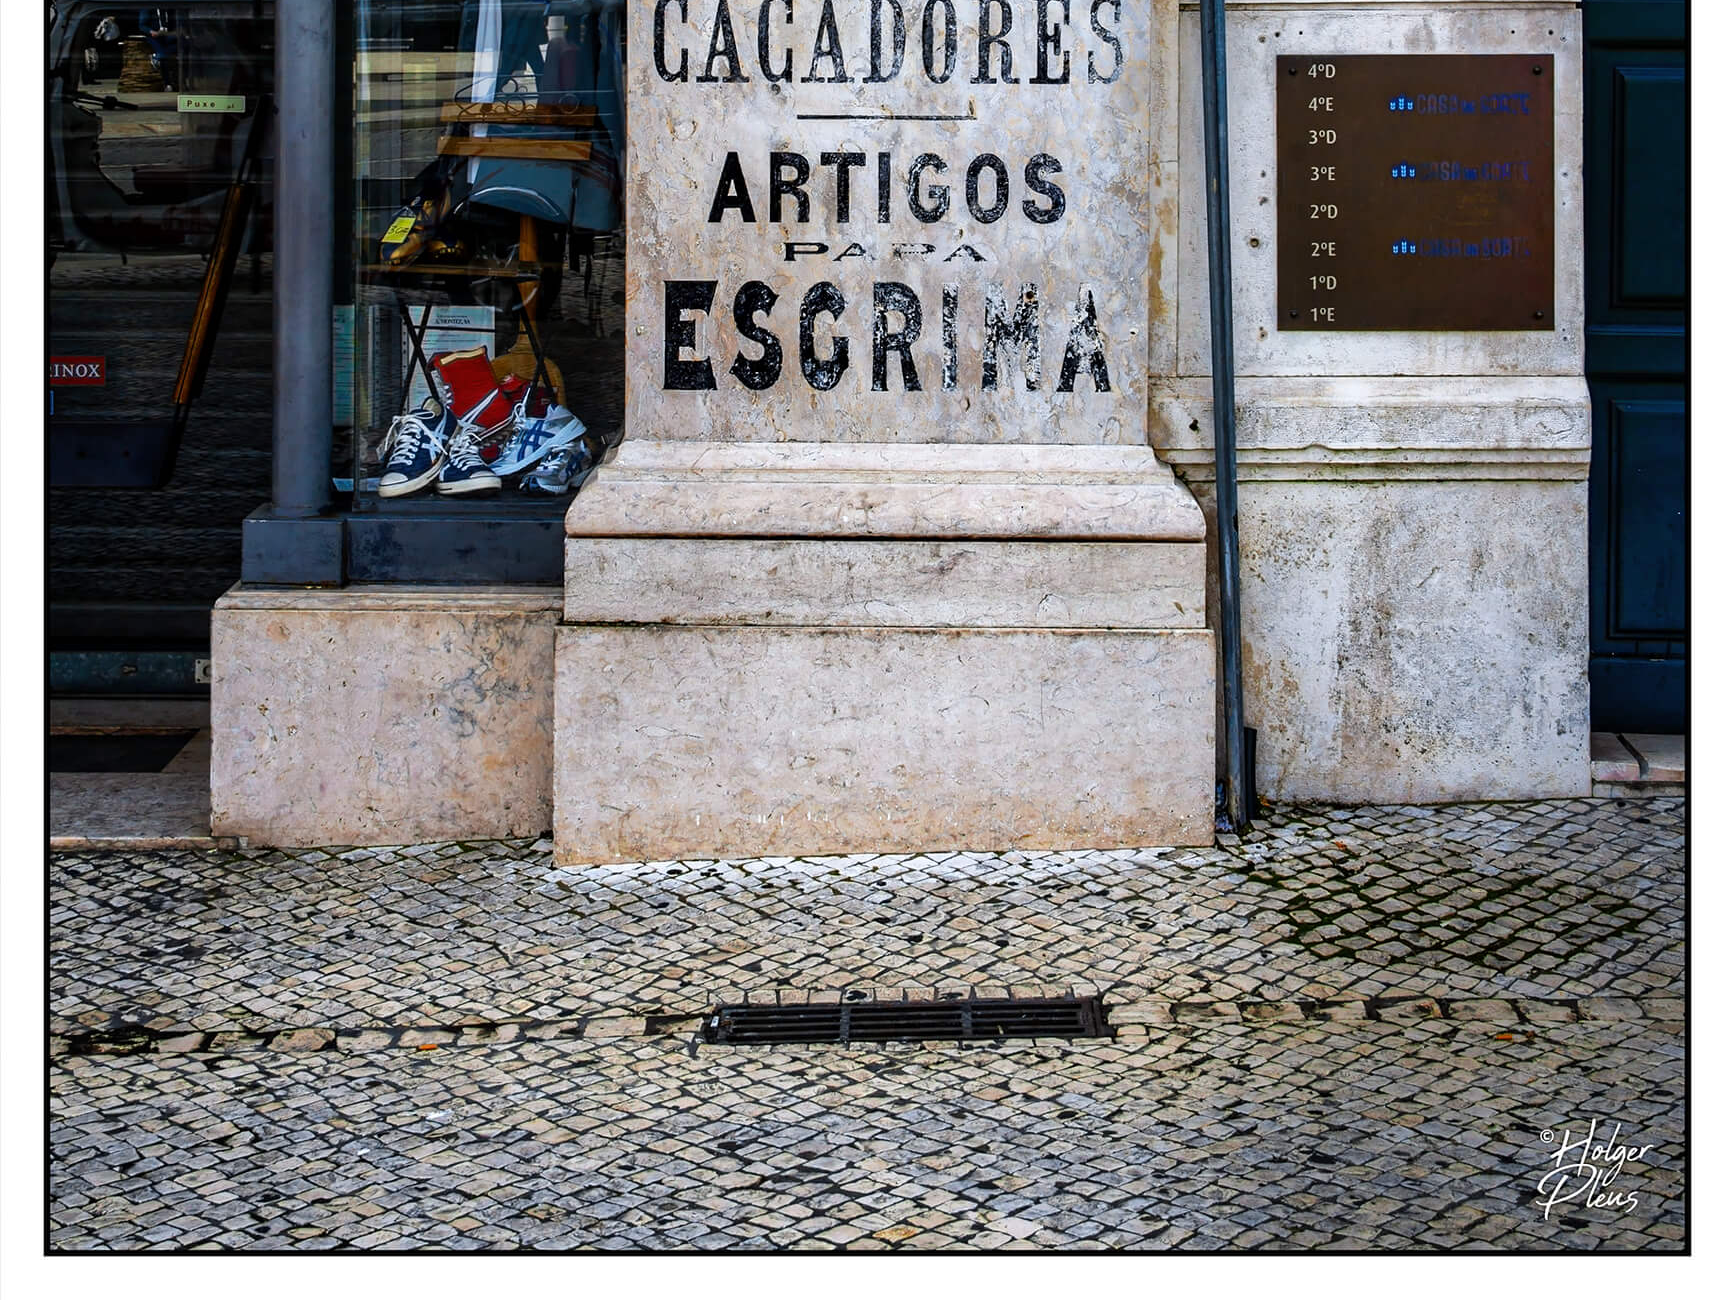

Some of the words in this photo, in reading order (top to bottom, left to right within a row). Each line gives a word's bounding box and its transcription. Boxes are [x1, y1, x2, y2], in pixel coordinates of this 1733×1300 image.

[1308, 64, 1335, 78] 4ºD
[187, 100, 216, 108] Puxe
[1309, 97, 1333, 111] 4ºE
[1309, 130, 1336, 144] 3ºD
[1311, 167, 1335, 180] 3ºE
[708, 151, 1066, 224] ARTIGOS
[1311, 205, 1337, 218] 2ºD
[1312, 243, 1335, 256] 2ºE
[1310, 276, 1336, 289] 1ºD
[1311, 308, 1334, 321] 1ºE
[663, 280, 1110, 392] ESCRIMA
[50, 364, 100, 378] INOX
